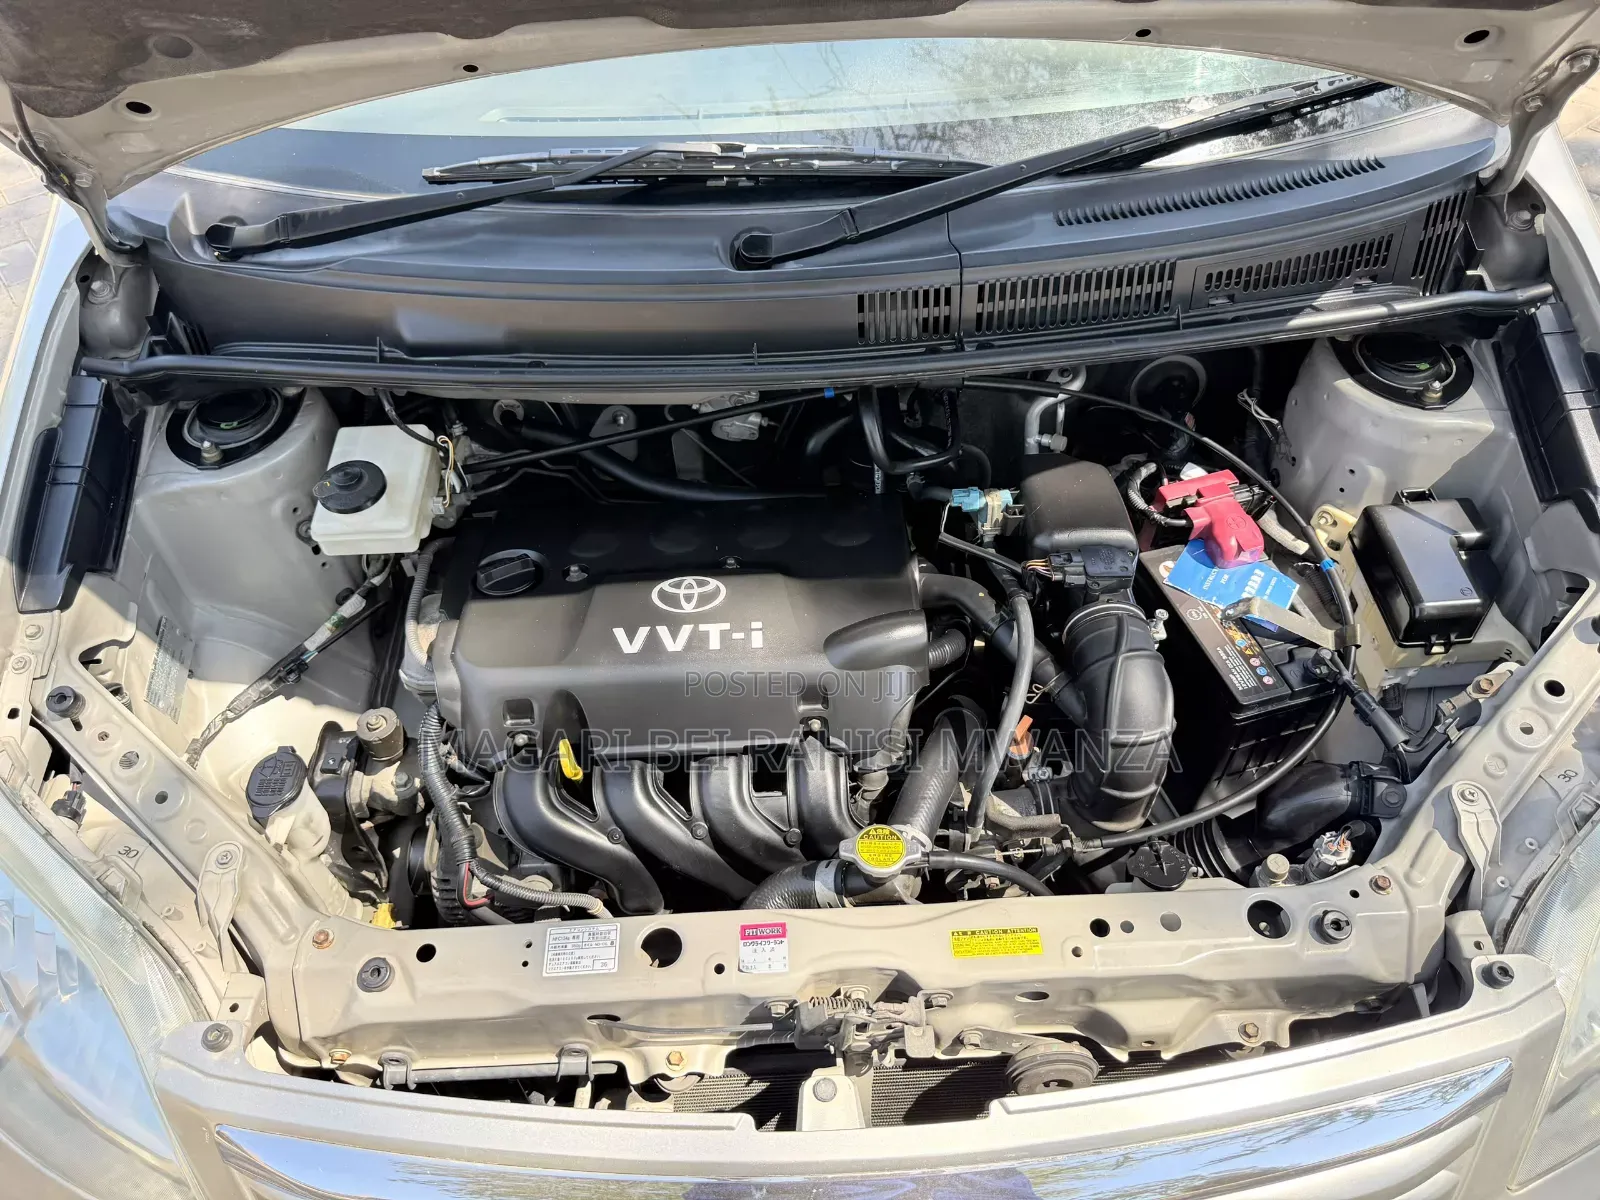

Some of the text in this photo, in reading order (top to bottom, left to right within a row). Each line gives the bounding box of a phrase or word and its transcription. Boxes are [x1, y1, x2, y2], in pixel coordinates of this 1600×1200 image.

[612, 621, 764, 654] VVT-i
[1557, 769, 1578, 783] 30
[118, 845, 139, 858] 30
